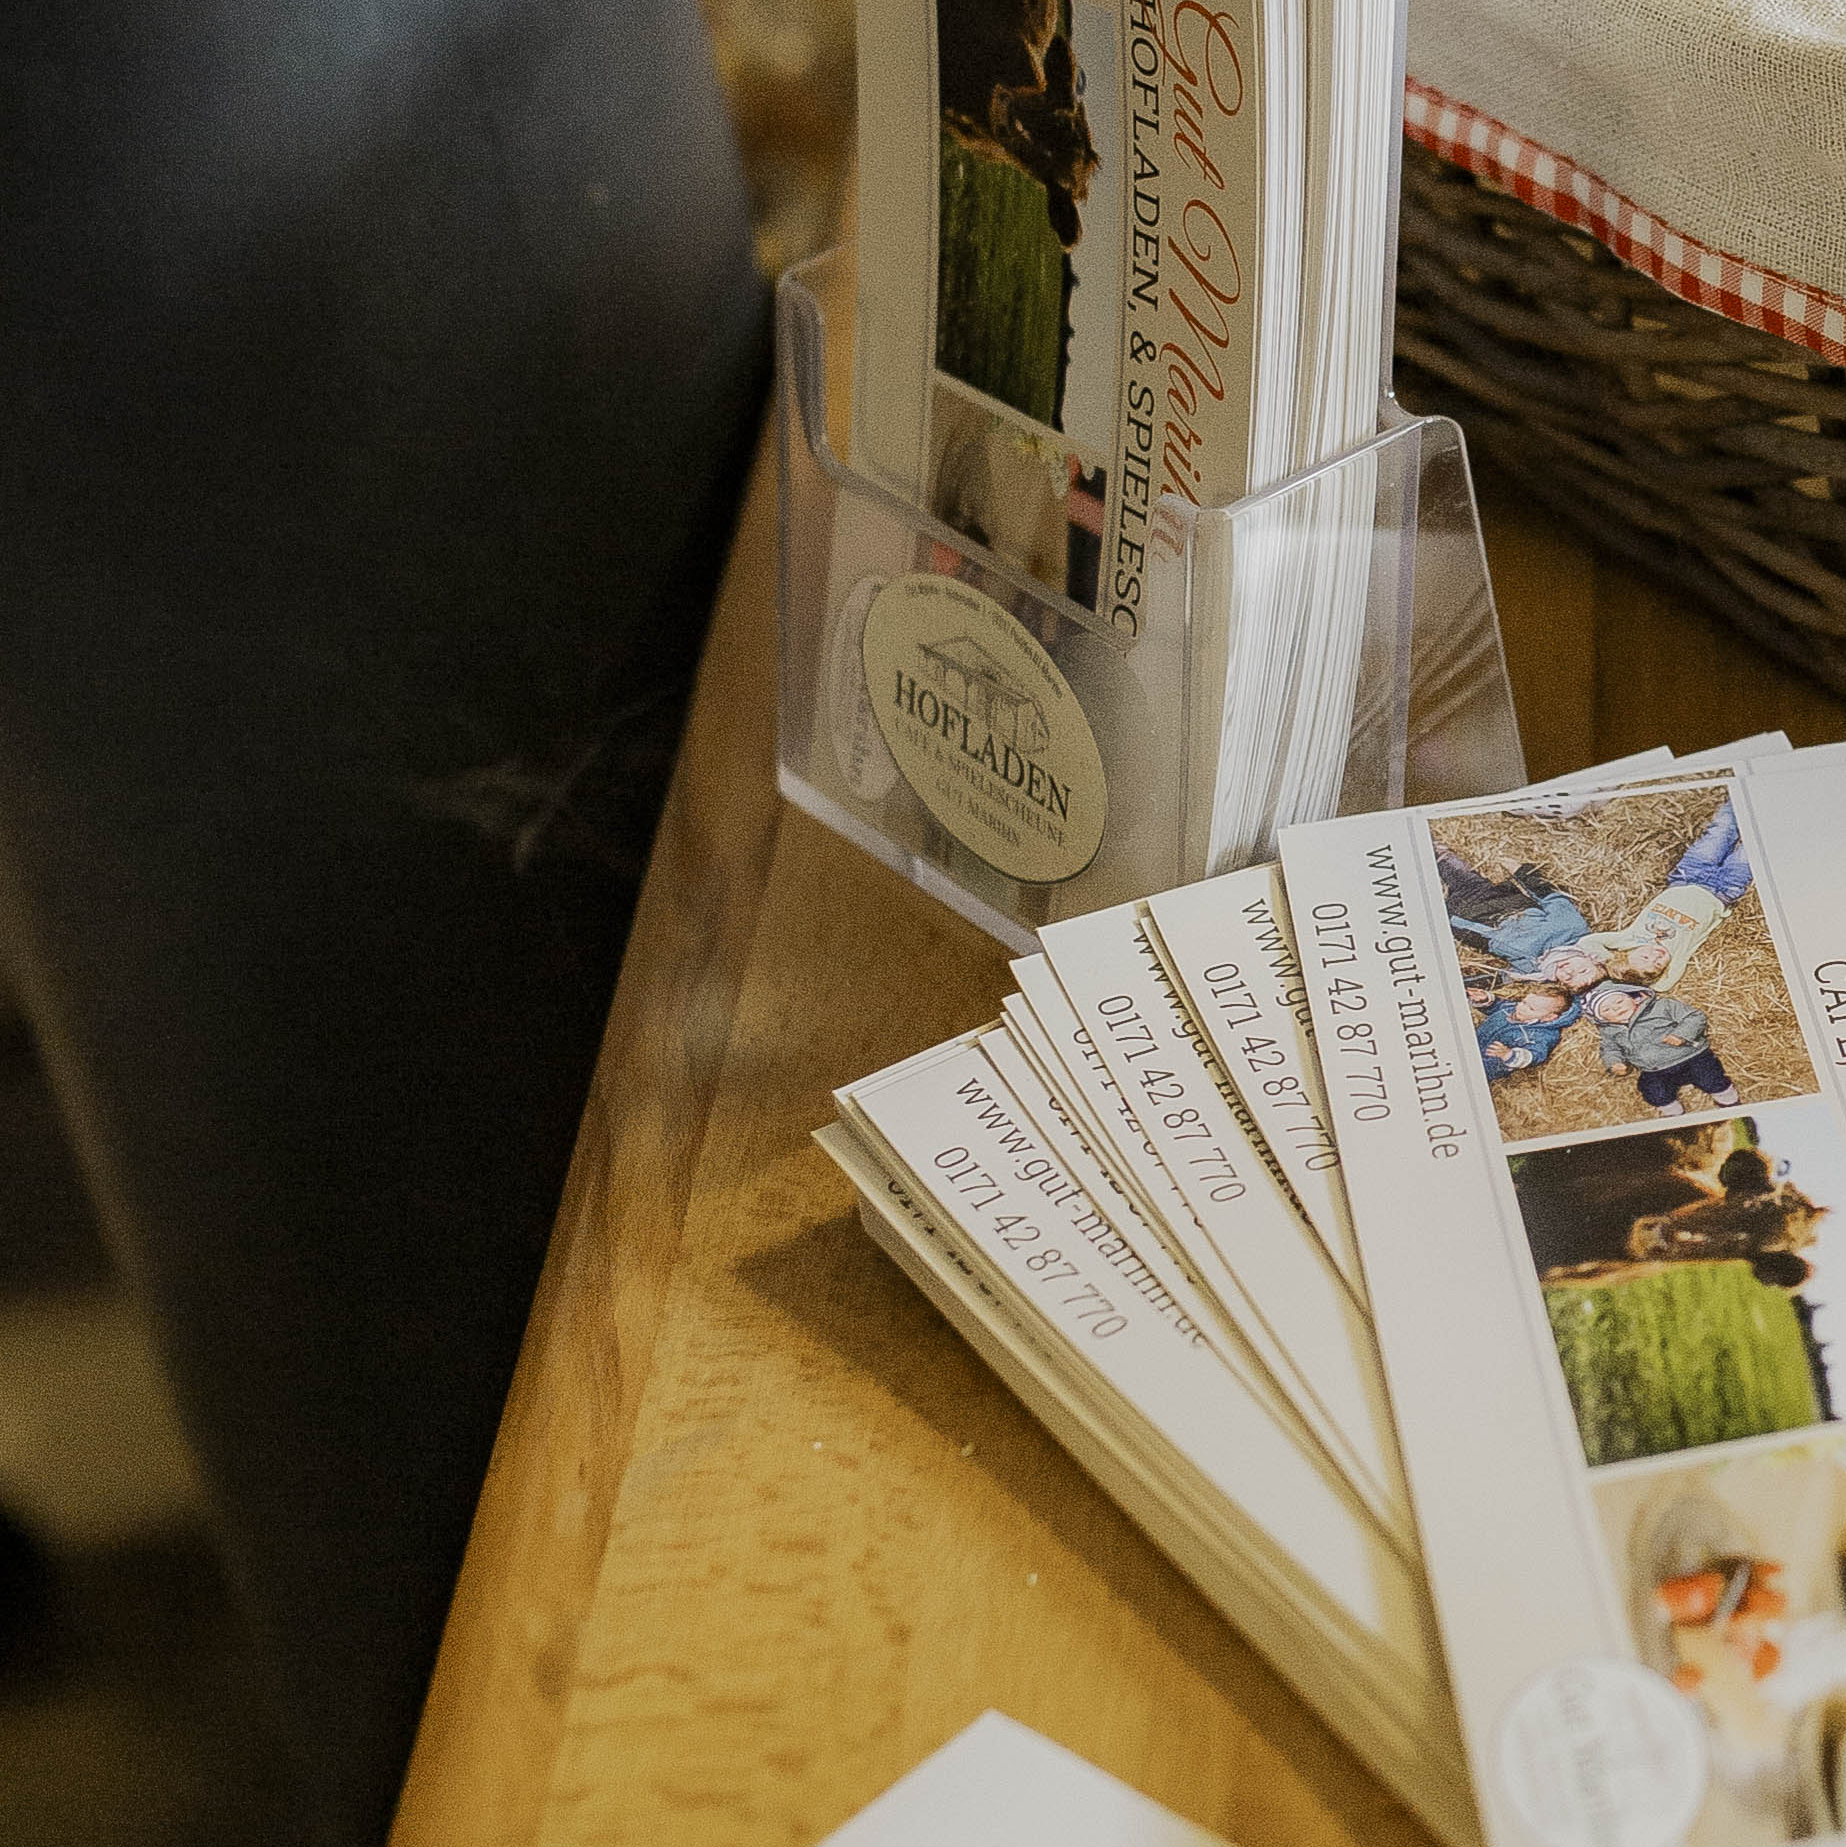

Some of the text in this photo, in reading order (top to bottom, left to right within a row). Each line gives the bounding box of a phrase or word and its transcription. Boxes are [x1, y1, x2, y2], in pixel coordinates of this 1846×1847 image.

[1128, 330, 1158, 364] &
[1111, 380, 1155, 637] SPIELESC
[893, 668, 1072, 823] HOFLADEN
[1097, 995, 1160, 1064] 0171
[1139, 1068, 1185, 1107] 42
[1163, 1107, 1213, 1143] 87
[1188, 1146, 1247, 1203] 770
[1203, 962, 1340, 1172] 0171 42 87 770
[1311, 903, 1391, 1122] 0171 42 87 770
[1366, 844, 1468, 1160] www.gut-marihn.de
[934, 1146, 1006, 1212] 0171
[994, 1214, 1041, 1251] 42
[1025, 1247, 1082, 1283] 87
[1063, 1282, 1129, 1340] 770
